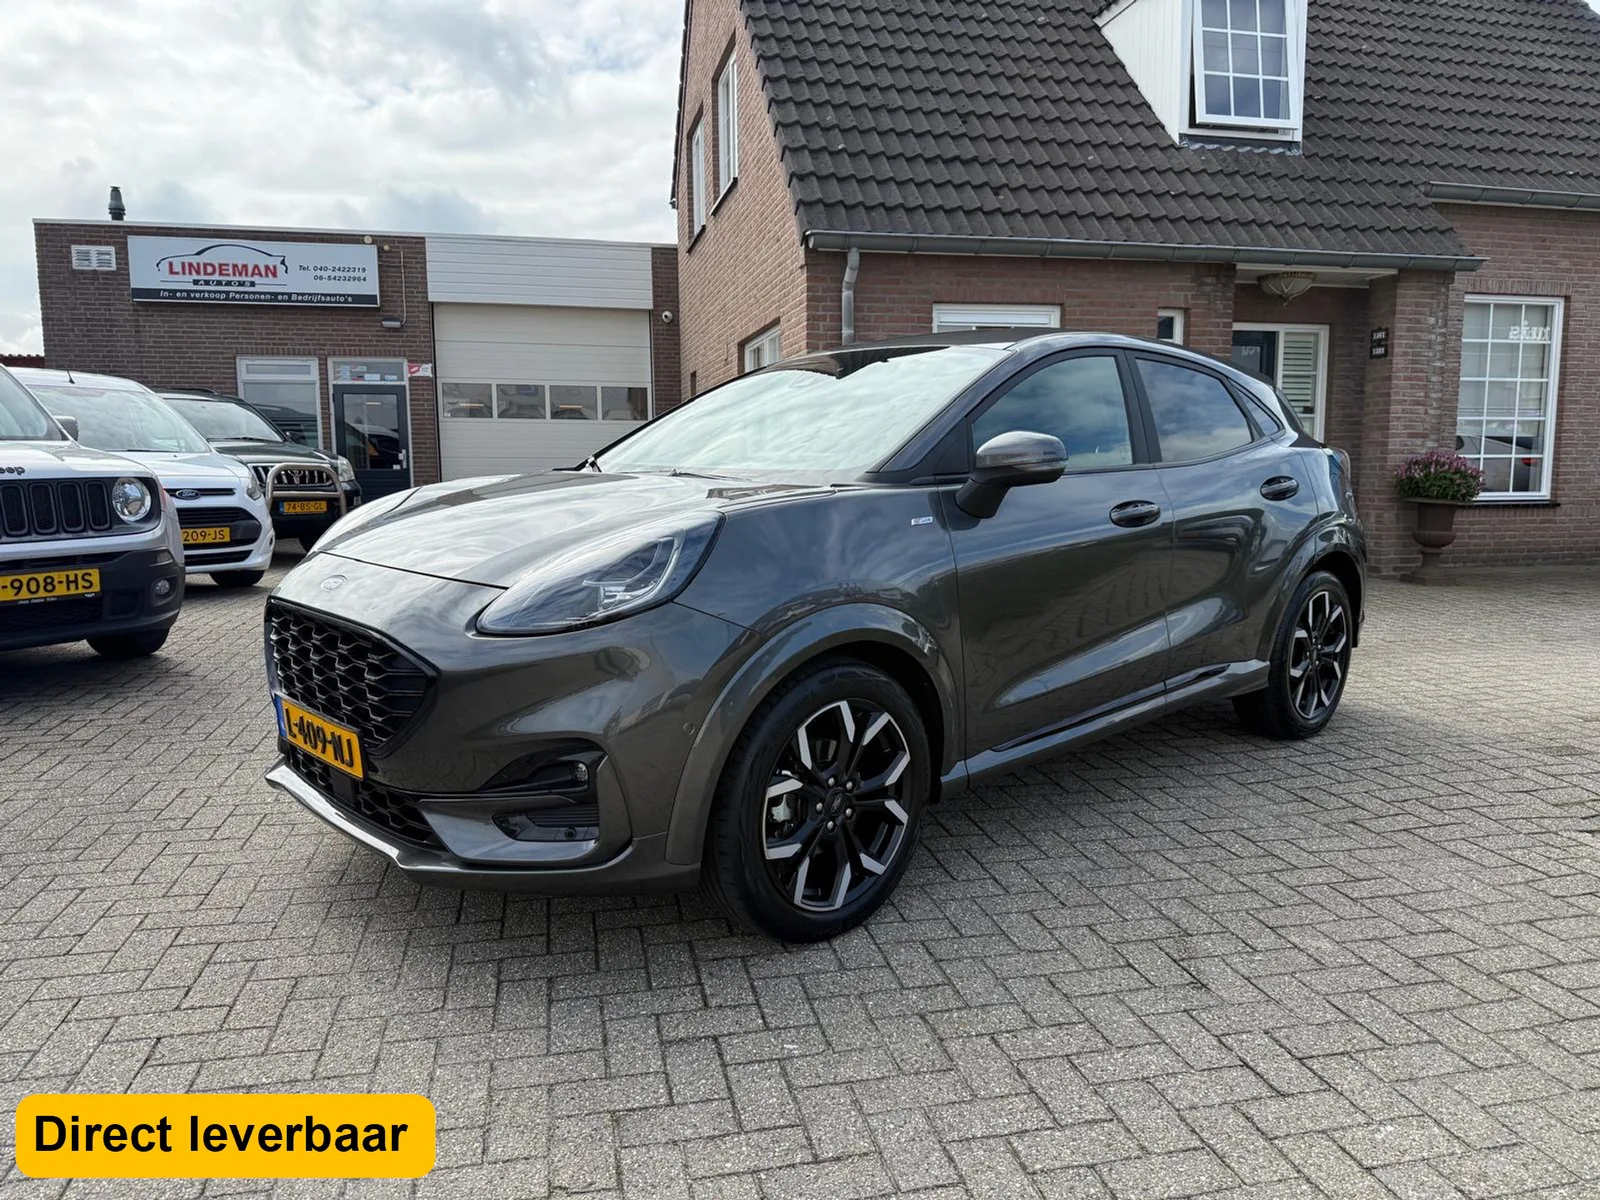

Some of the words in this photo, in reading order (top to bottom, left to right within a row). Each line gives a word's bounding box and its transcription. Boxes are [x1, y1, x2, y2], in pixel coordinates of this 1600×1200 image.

[168, 261, 278, 278] LINDEMAN
[313, 265, 366, 273] 040-2422319
[313, 274, 366, 282] 06-54232964
[190, 290, 226, 300] verkoop
[229, 292, 275, 300] Personen-
[291, 293, 353, 303] Bedrijfsauto's
[286, 502, 325, 511] 74-BS-GL
[285, 707, 355, 768] L-409-NJ
